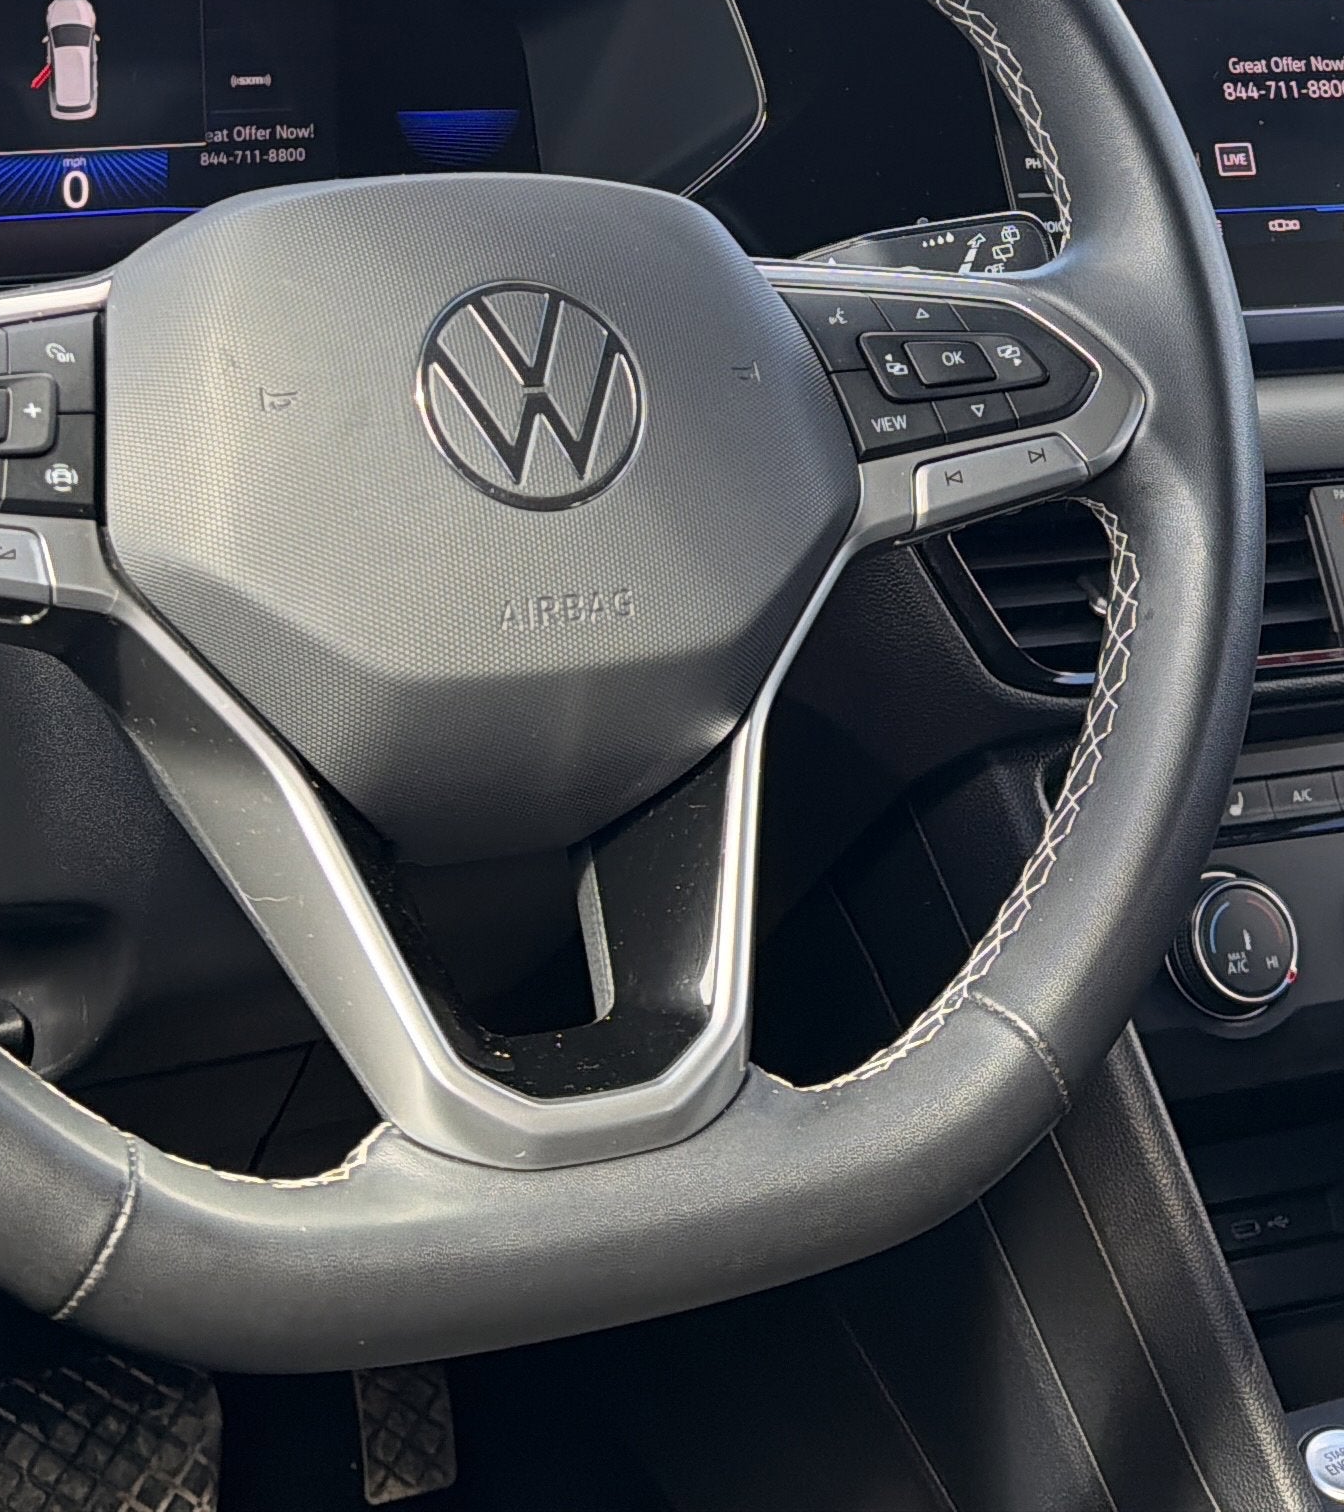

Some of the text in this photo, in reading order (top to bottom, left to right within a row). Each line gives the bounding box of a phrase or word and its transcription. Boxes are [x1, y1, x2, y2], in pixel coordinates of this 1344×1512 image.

[1228, 57, 1268, 74] Great
[1271, 56, 1306, 73] Offer
[205, 123, 315, 143] eat Offer Now!
[62, 157, 87, 169] mph
[200, 147, 306, 167] 844-711-8800
[1223, 153, 1248, 166] LIVE
[62, 170, 90, 209] 0
[941, 350, 964, 367] OK
[871, 414, 908, 433] VIEW
[499, 587, 637, 635] AIRBAG
[1292, 788, 1313, 803] A/C
[1227, 960, 1250, 975] A/C
